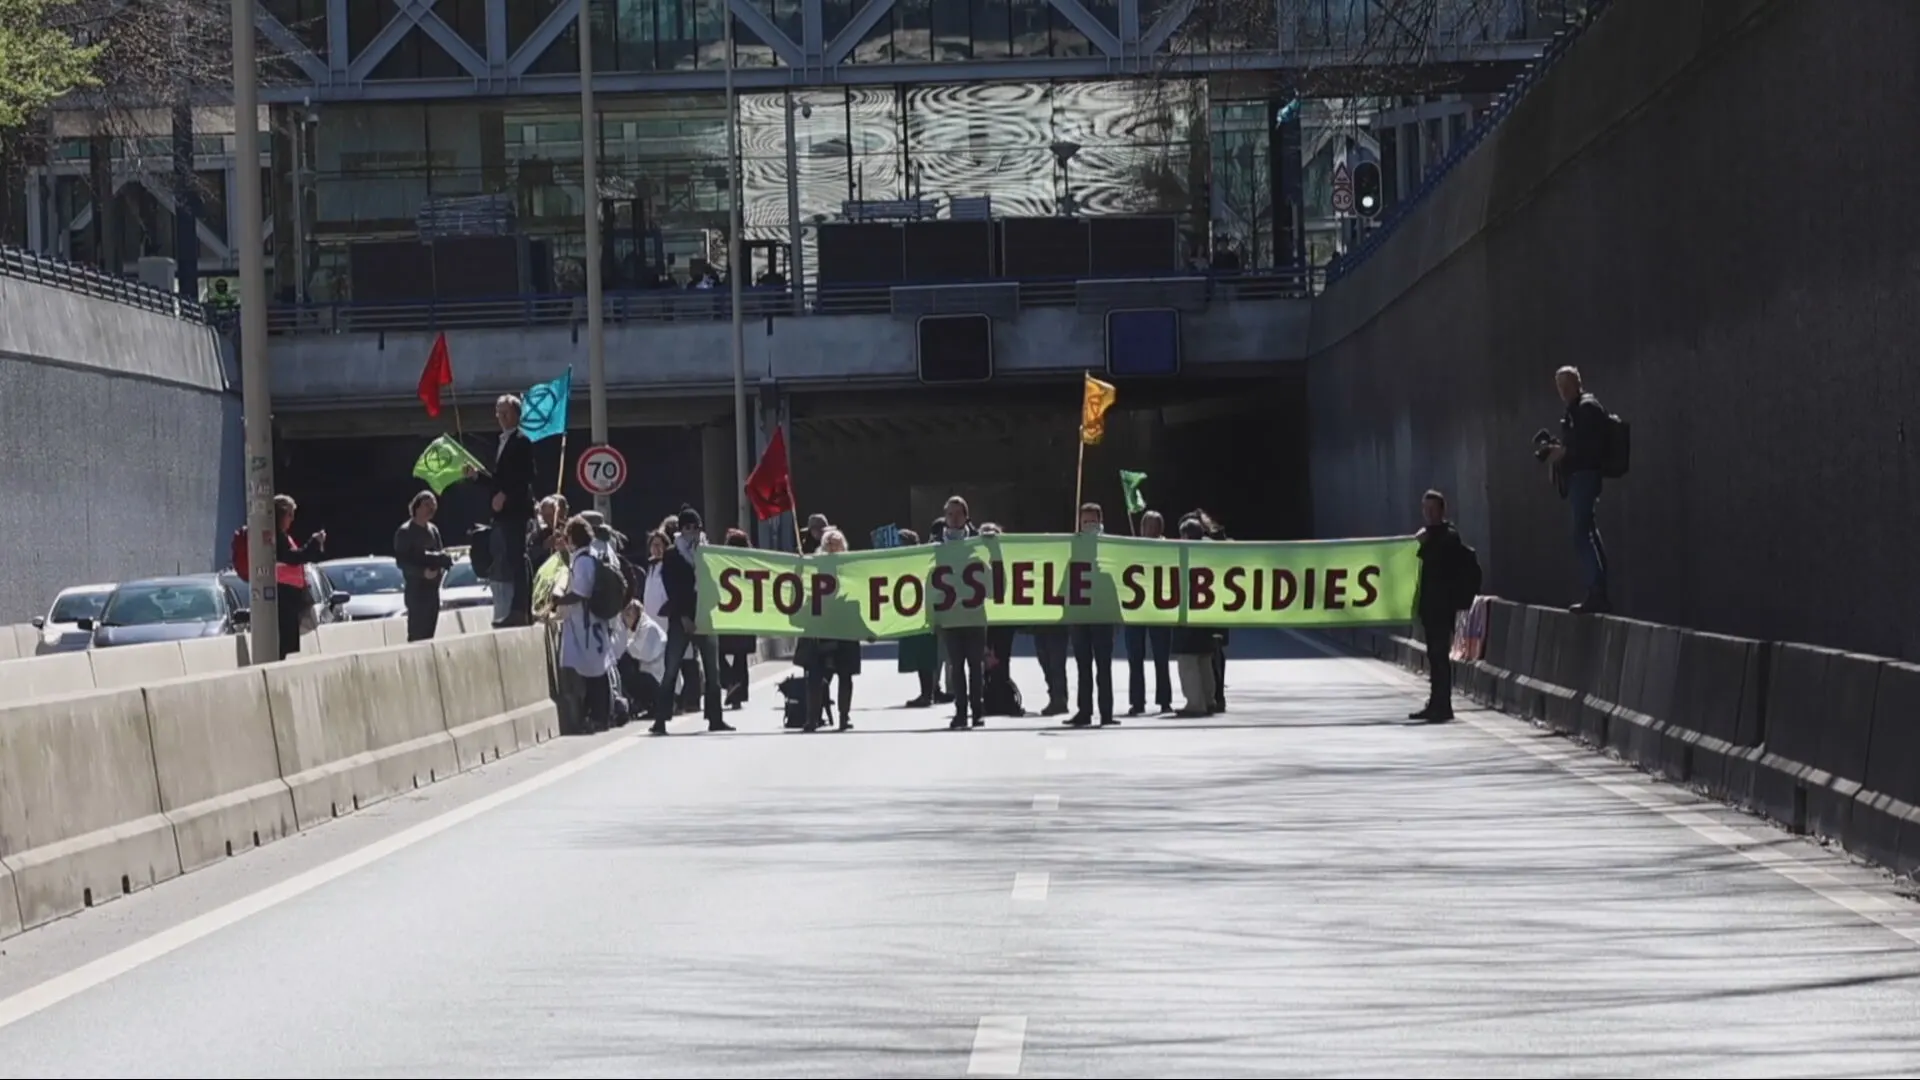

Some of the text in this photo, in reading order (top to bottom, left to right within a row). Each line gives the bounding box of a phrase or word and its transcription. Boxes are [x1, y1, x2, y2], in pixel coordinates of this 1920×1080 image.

[588, 461, 617, 480] 70
[718, 561, 1380, 622] STOP FOSSIELE SUBSIDIES
